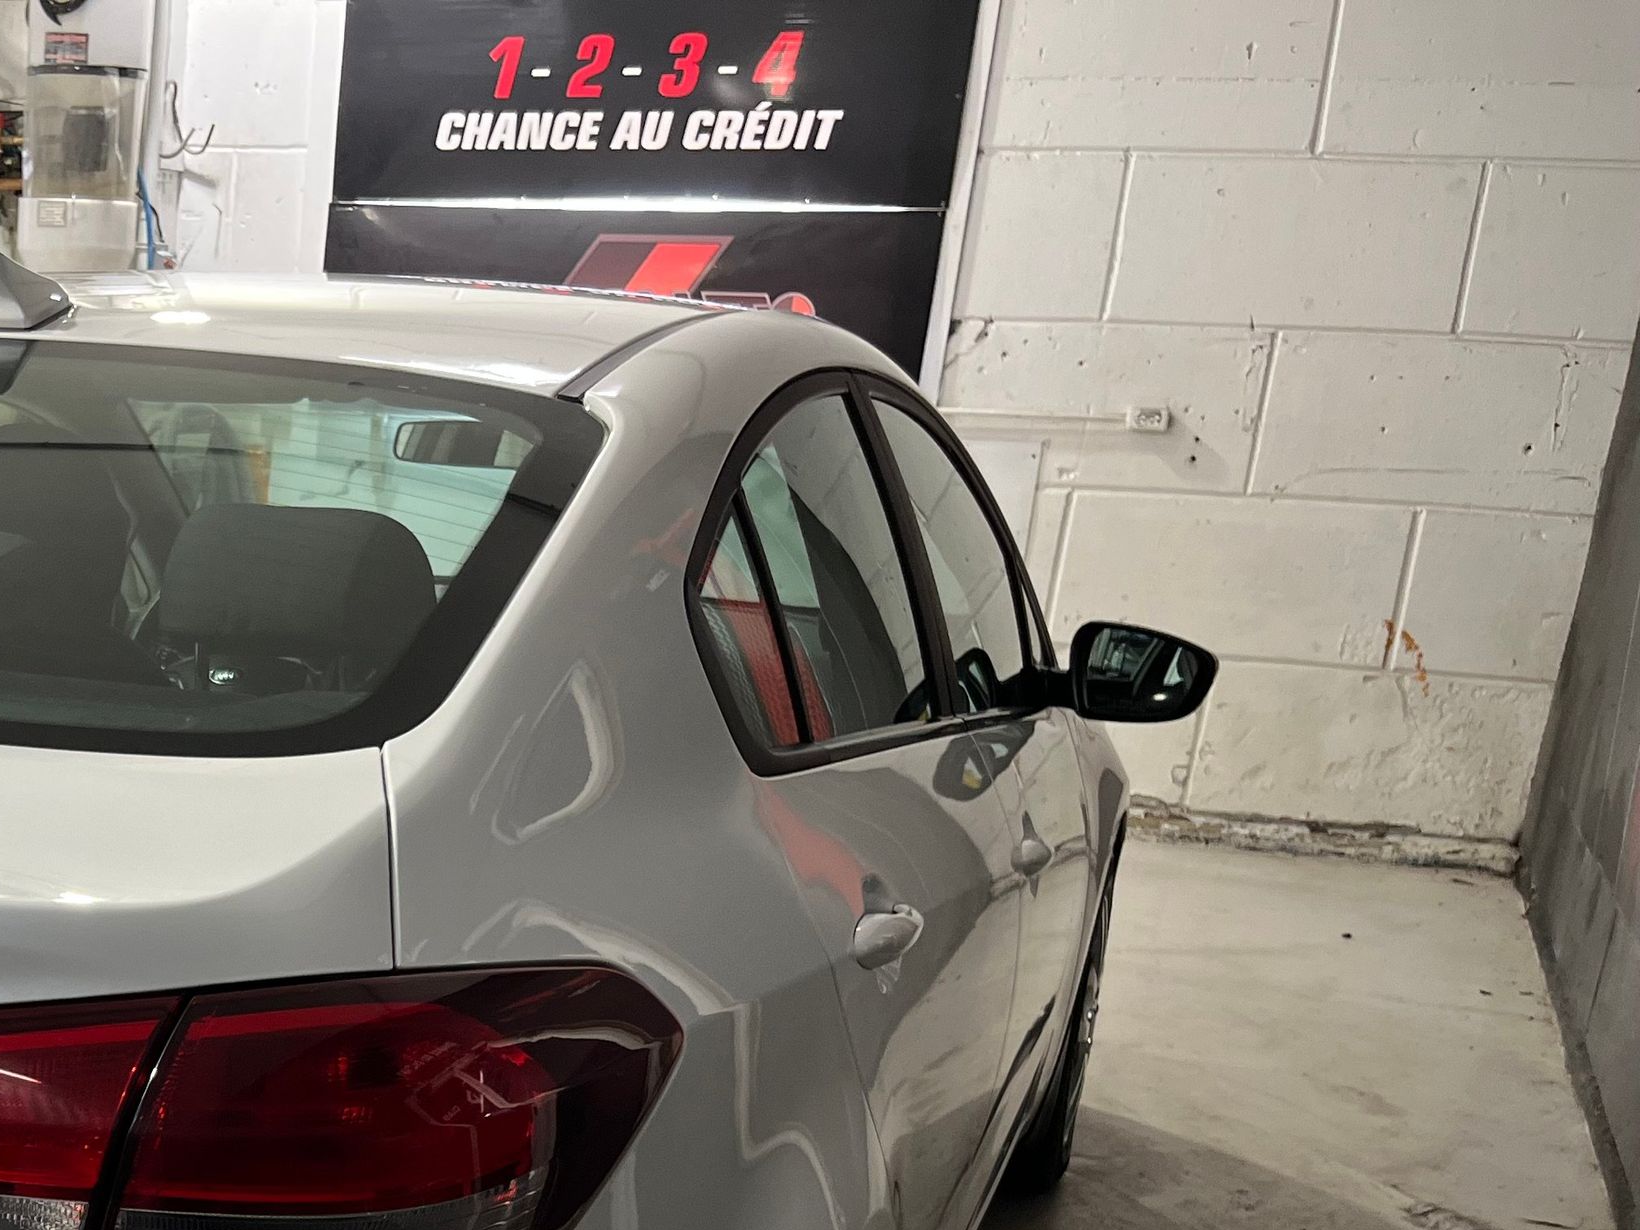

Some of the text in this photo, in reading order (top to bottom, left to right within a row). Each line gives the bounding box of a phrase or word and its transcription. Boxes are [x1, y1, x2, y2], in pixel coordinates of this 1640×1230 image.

[434, 101, 844, 151] CHANCE AU CRÉDIT
